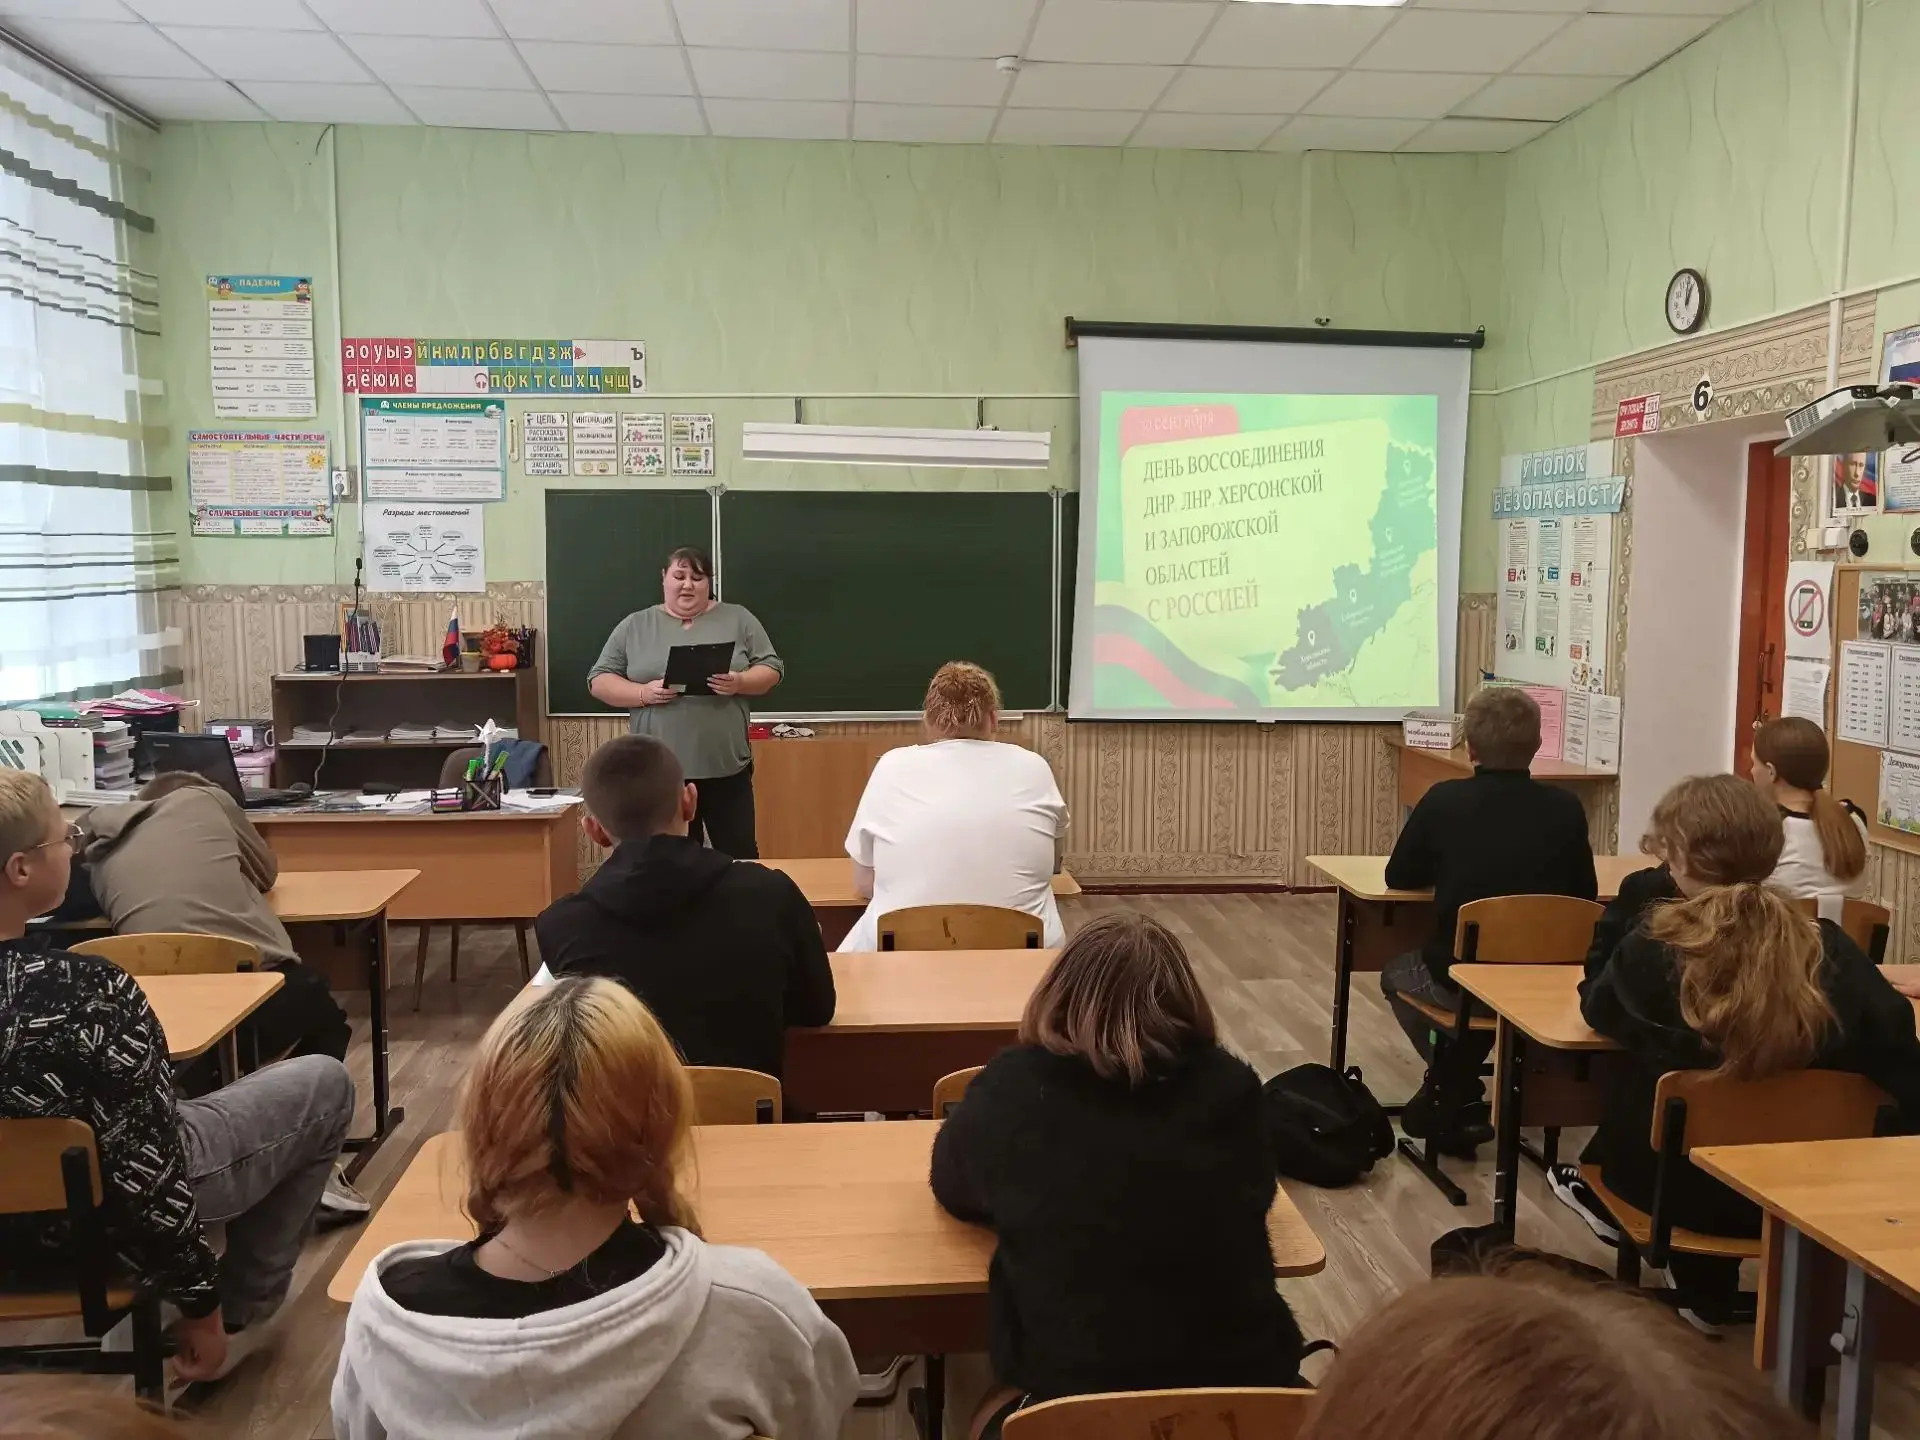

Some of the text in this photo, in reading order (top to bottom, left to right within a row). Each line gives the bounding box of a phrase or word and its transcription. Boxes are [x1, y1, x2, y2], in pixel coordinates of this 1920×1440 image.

[239, 278, 281, 287] ПАДЕЖИ
[392, 401, 482, 410] ЧЛЕНЫ ПРЕДЛОЖЕНИЯ
[1694, 380, 1711, 411] 6
[192, 433, 325, 441] САМОСТОЯТЕЛЬНЫЕ ЧАСТИ РЕЧИ
[1143, 438, 1325, 484] ДЕНЬ ВОССОЕДИНЕНИЯ
[1522, 450, 1586, 479] УГОЛОК
[1218, 468, 1324, 507] ХЕРСОНСКОЙ
[1492, 480, 1625, 513] БЕЗОПАСНОСТИ
[208, 509, 313, 517] СЛУЖЕБНЫЕ ЧАСТИ РЕЧИ
[382, 508, 471, 517] Разряды местоимений
[1144, 510, 1280, 551] И ЗАПОРОЖСКОЙ
[1144, 551, 1230, 585] ОБЛАСТЕЙ
[1146, 579, 1261, 624] С РОССИЕЙ
[112, 1144, 164, 1193] GAP
[151, 1180, 193, 1227] GAP
